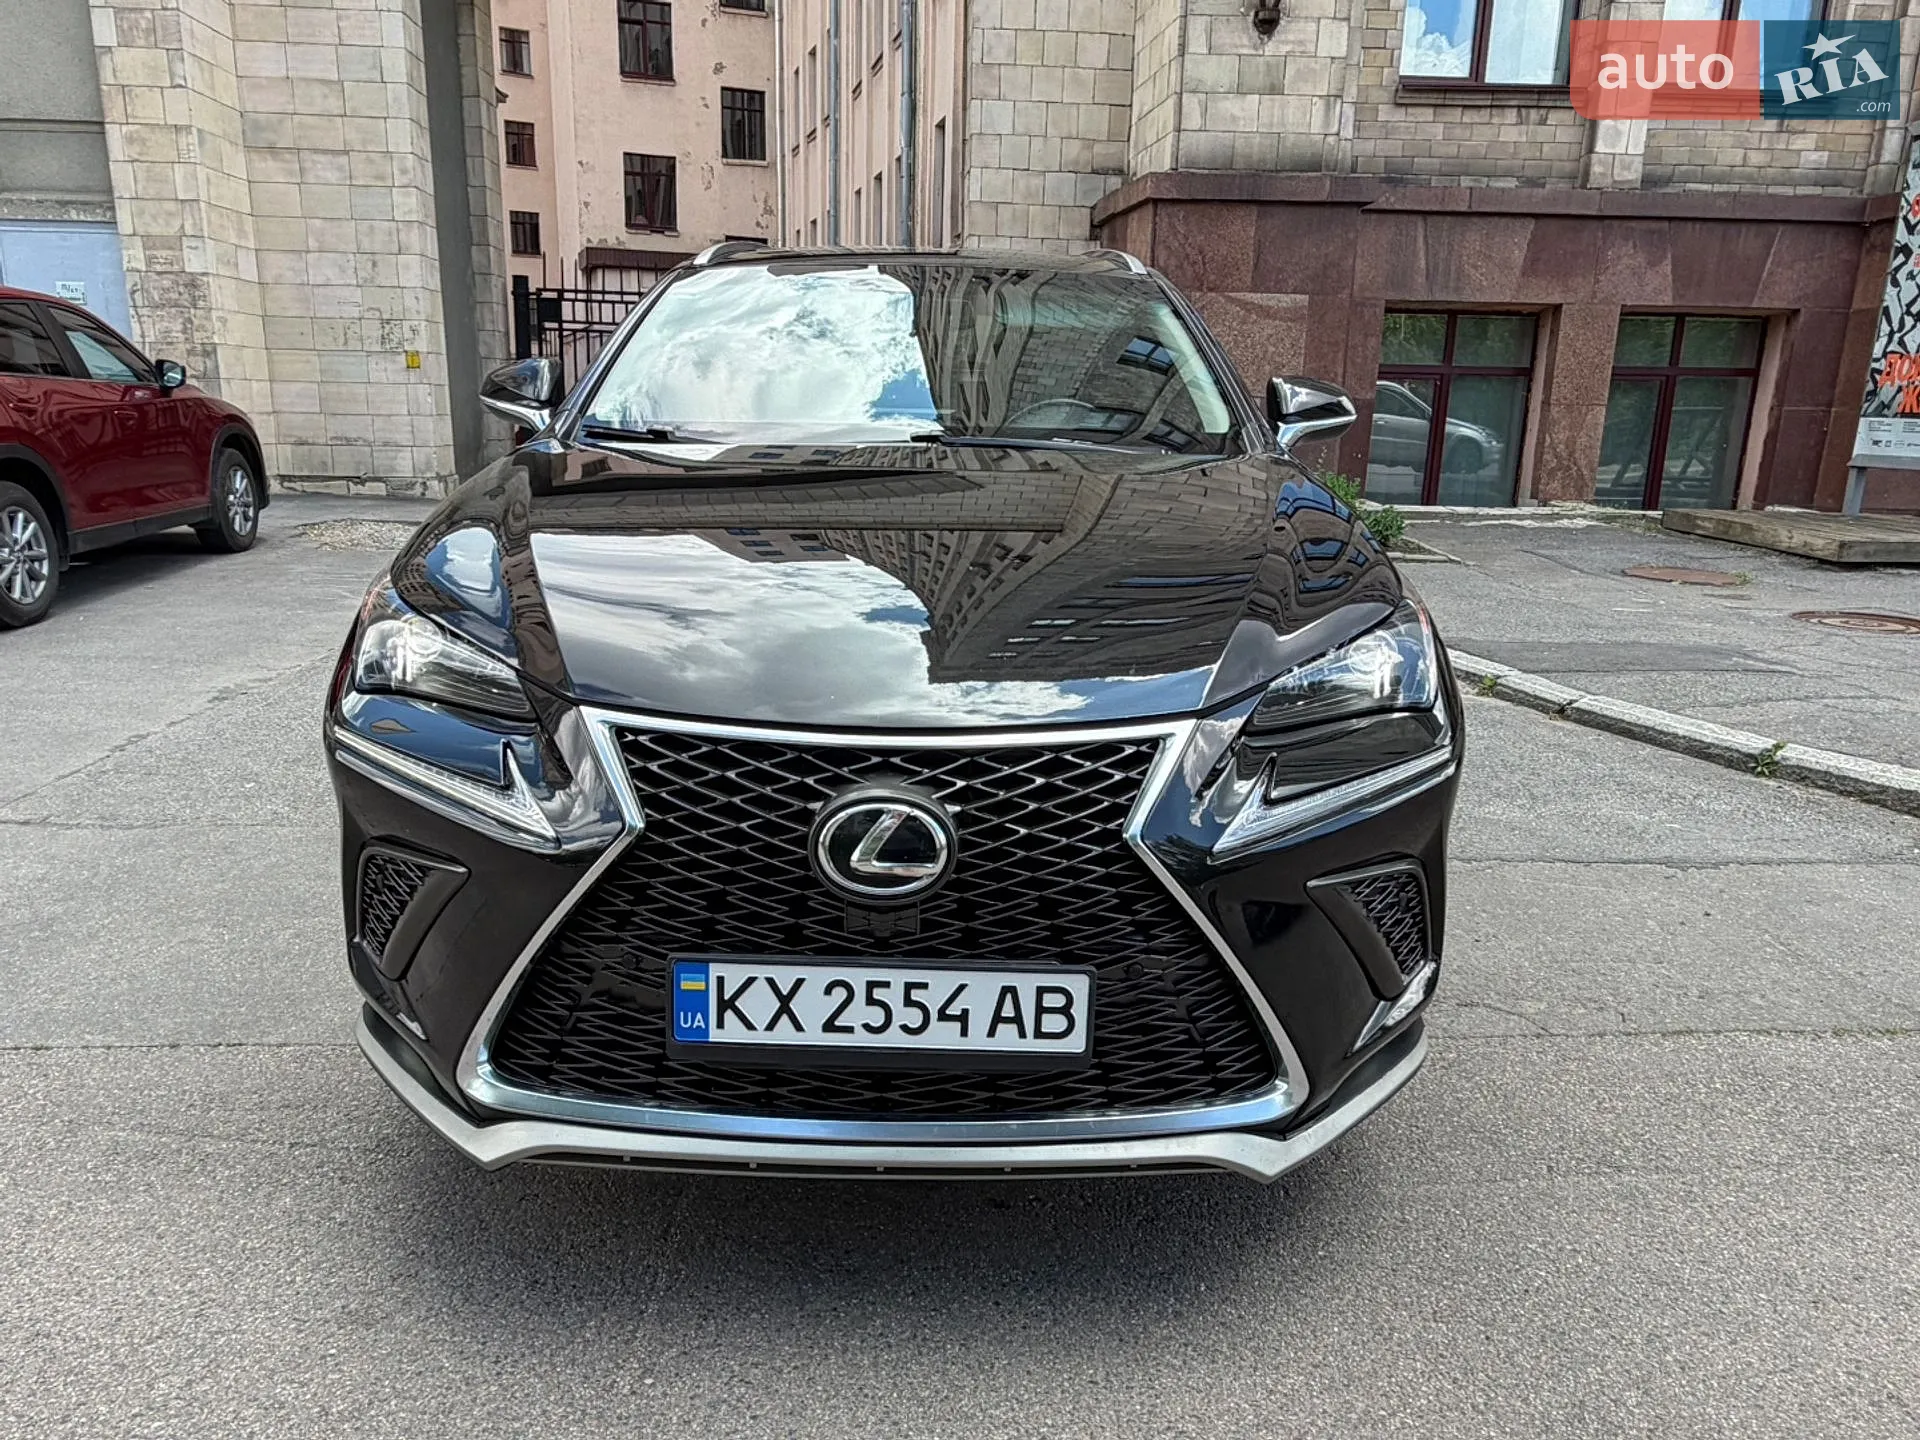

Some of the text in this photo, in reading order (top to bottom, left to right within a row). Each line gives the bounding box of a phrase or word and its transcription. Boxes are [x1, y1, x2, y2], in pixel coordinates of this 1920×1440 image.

[679, 1011, 706, 1030] UA
[715, 974, 1076, 1040] KX 2554 AB
